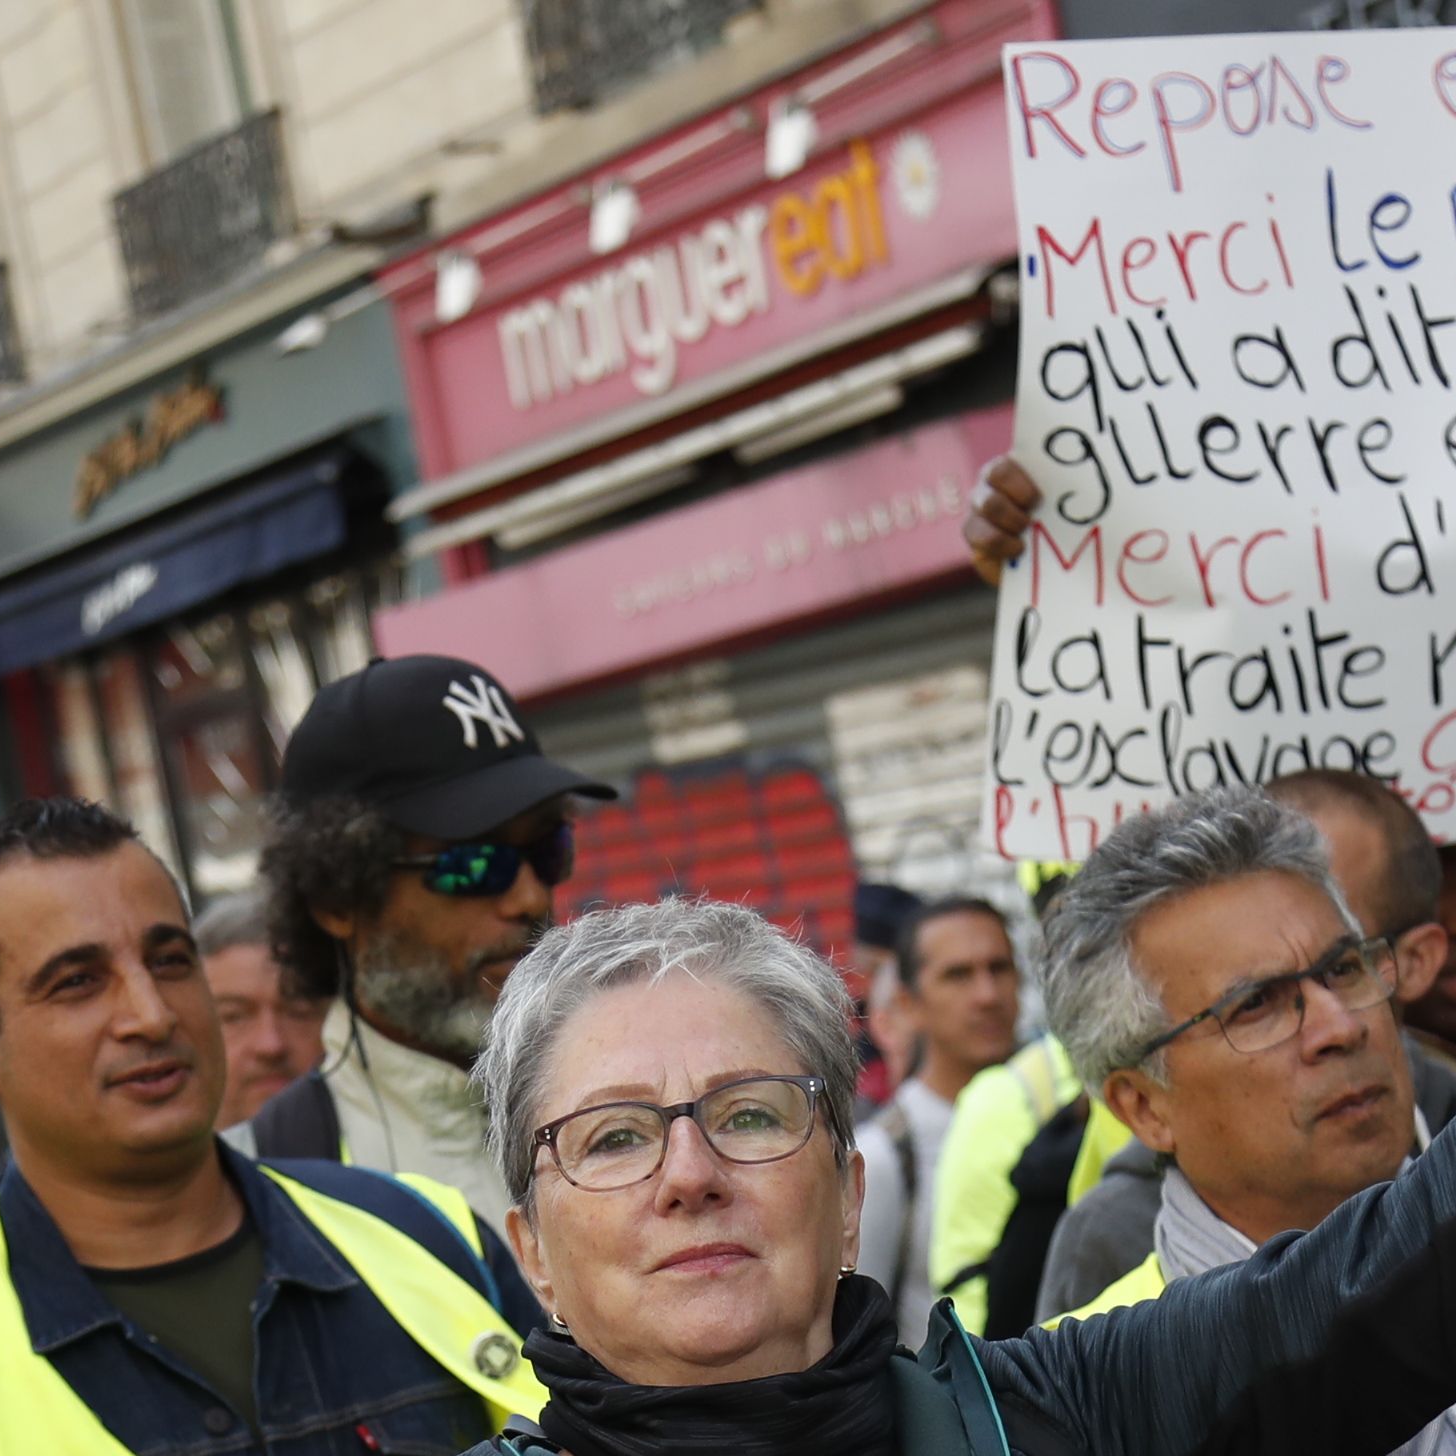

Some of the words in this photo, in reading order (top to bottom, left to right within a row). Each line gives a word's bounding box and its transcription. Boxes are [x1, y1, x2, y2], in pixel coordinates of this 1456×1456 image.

[1012, 50, 1374, 193] Repose
[498, 139, 891, 412] marguereat
[1035, 192, 1295, 320] Merci
[1041, 307, 1199, 433] qui
[1232, 324, 1307, 393] a
[1044, 402, 1407, 526] guerre
[1030, 507, 1331, 608] Merci
[442, 674, 525, 751] NY
[1015, 606, 1113, 700] la
[1135, 608, 1386, 715] traite
